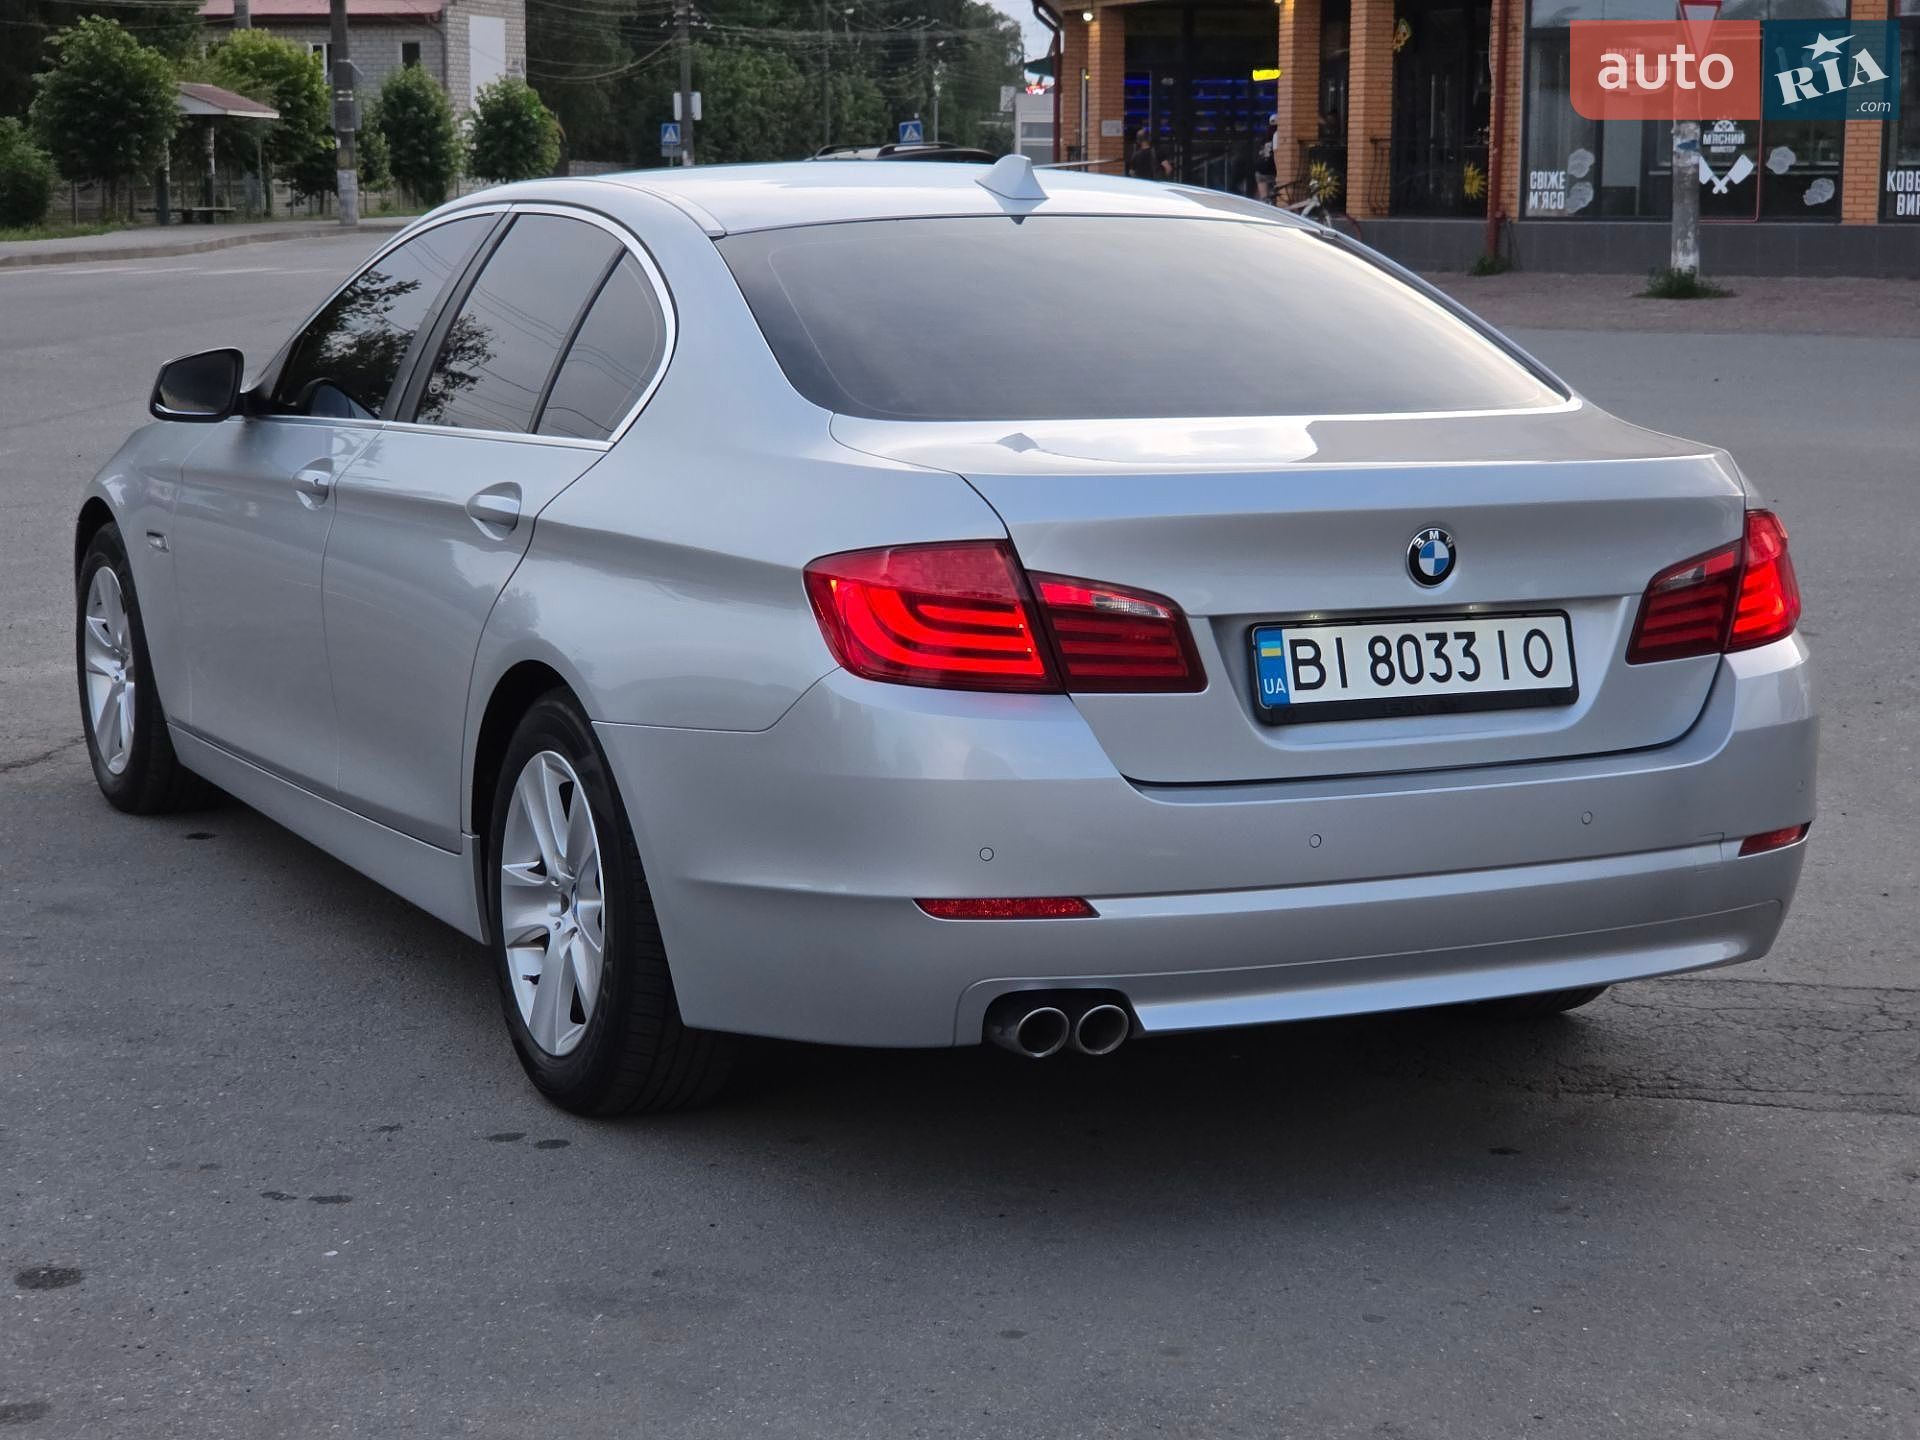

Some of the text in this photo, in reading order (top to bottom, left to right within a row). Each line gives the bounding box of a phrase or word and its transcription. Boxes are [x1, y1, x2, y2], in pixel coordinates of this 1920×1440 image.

[1529, 170, 1566, 190] СВІЖЕ
[1529, 191, 1565, 209] М'ЯСО
[1289, 628, 1553, 691] BI 8033 IO
[1263, 677, 1287, 695] UA
